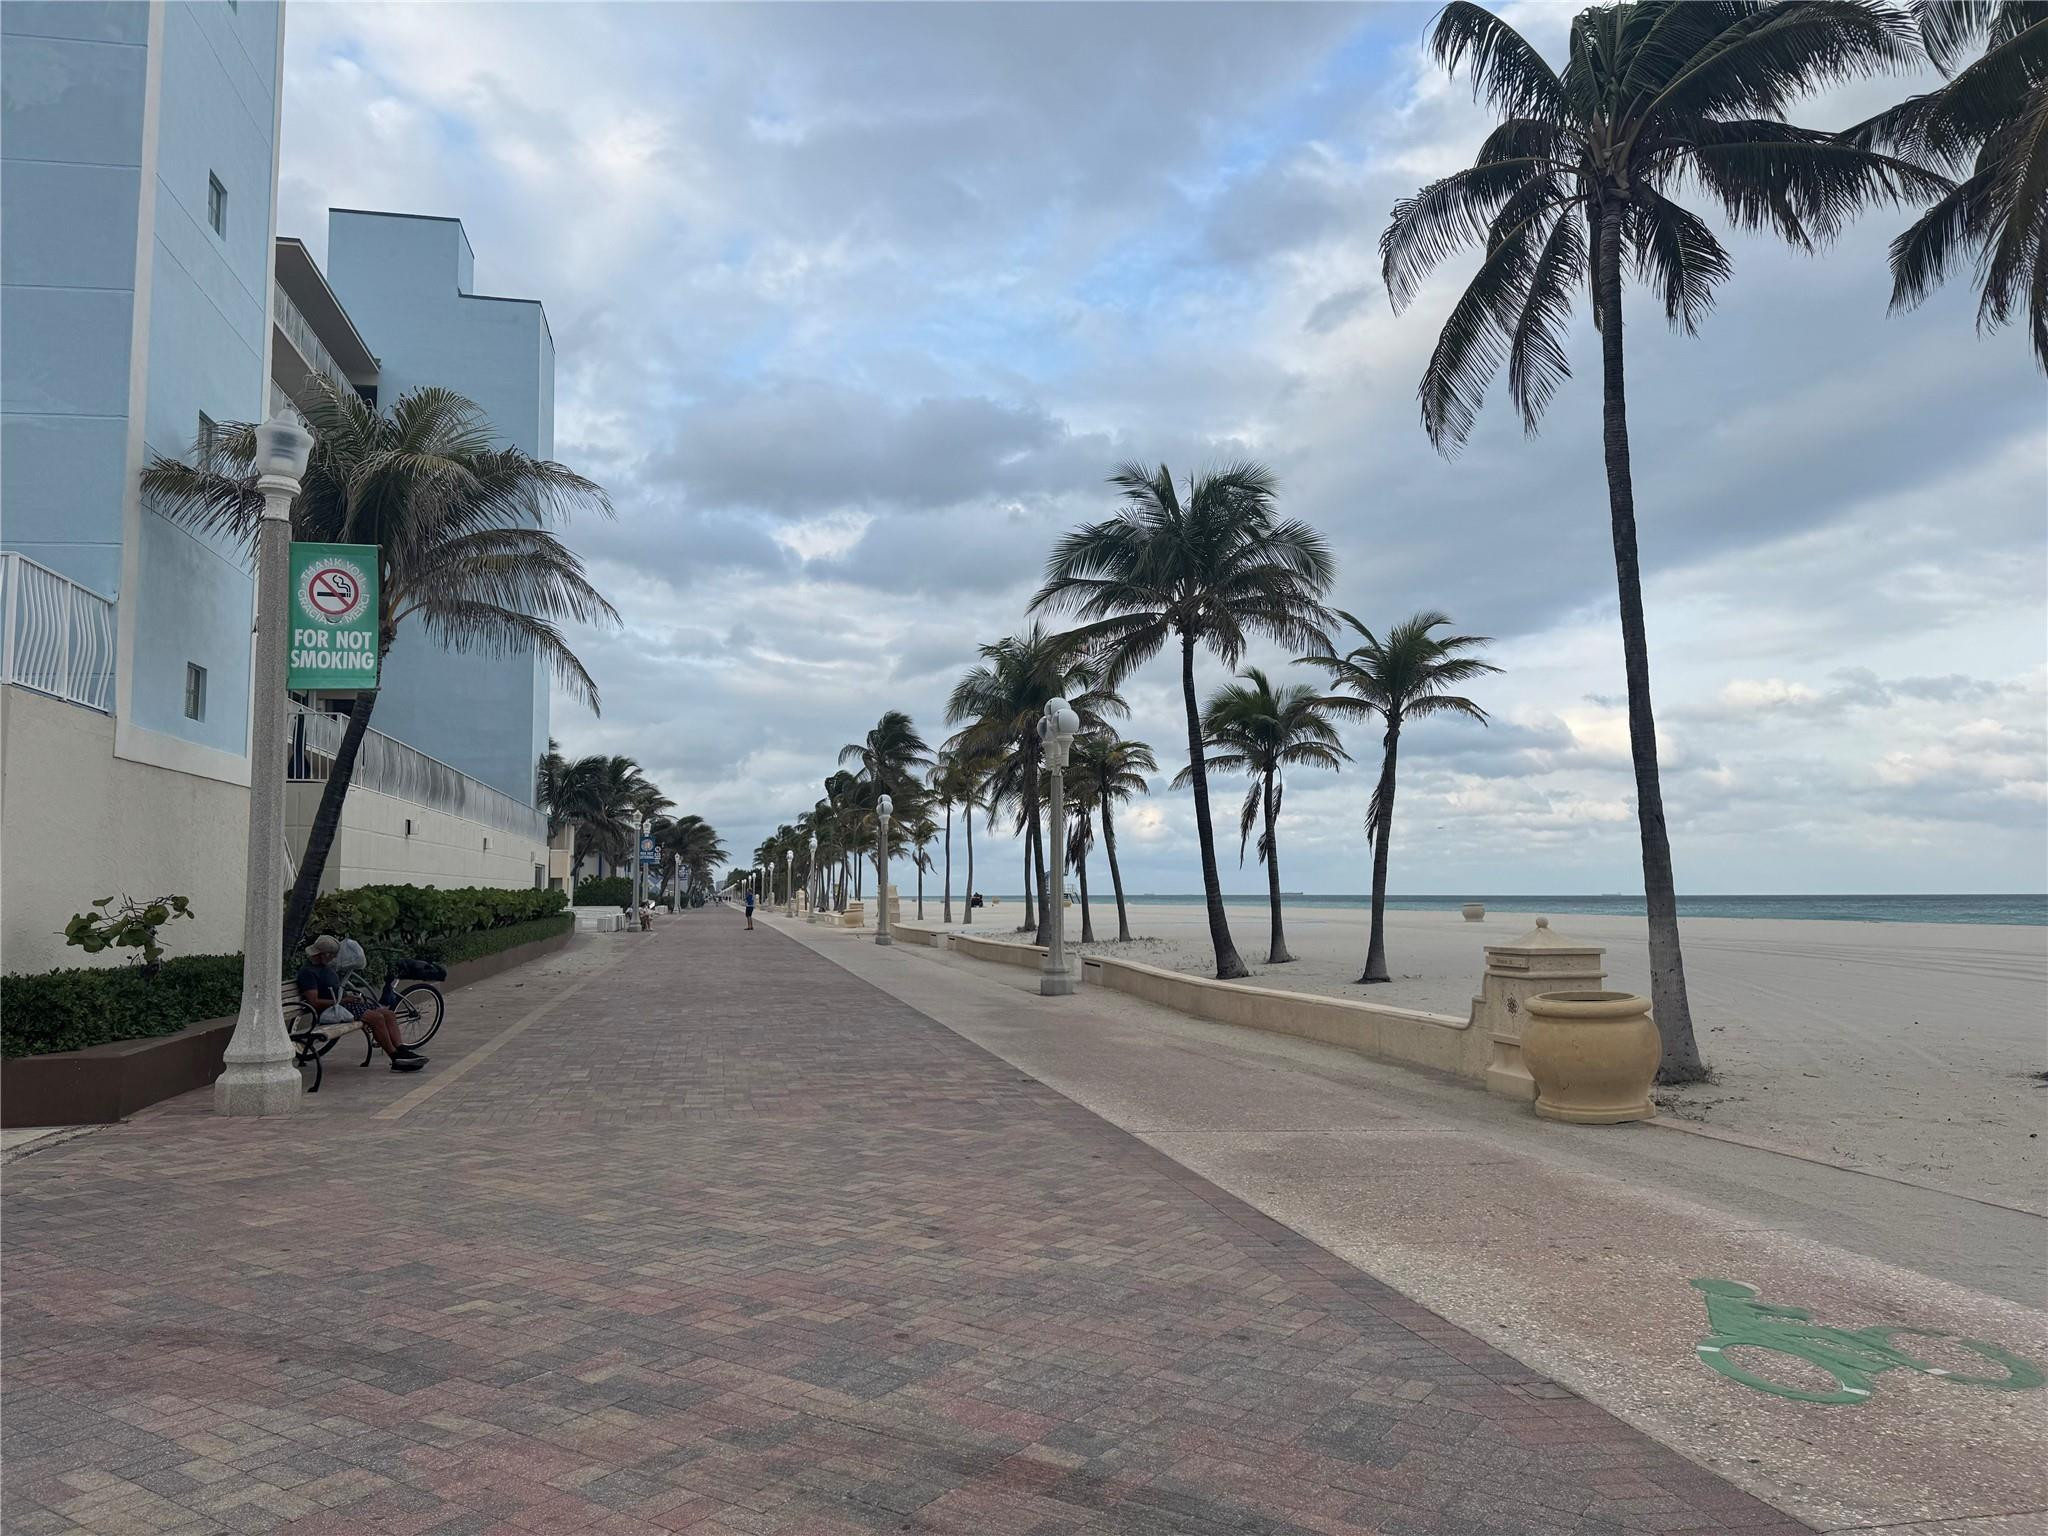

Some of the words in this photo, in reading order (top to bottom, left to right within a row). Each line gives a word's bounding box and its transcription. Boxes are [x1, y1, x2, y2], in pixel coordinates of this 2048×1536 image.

[300, 557, 342, 579] THANK
[346, 560, 367, 582] YOU
[298, 589, 332, 624] GRACIA
[344, 594, 370, 623] MERCI
[295, 629, 328, 648] FOR
[336, 632, 372, 649] NOT
[291, 650, 374, 669] SMOKING
